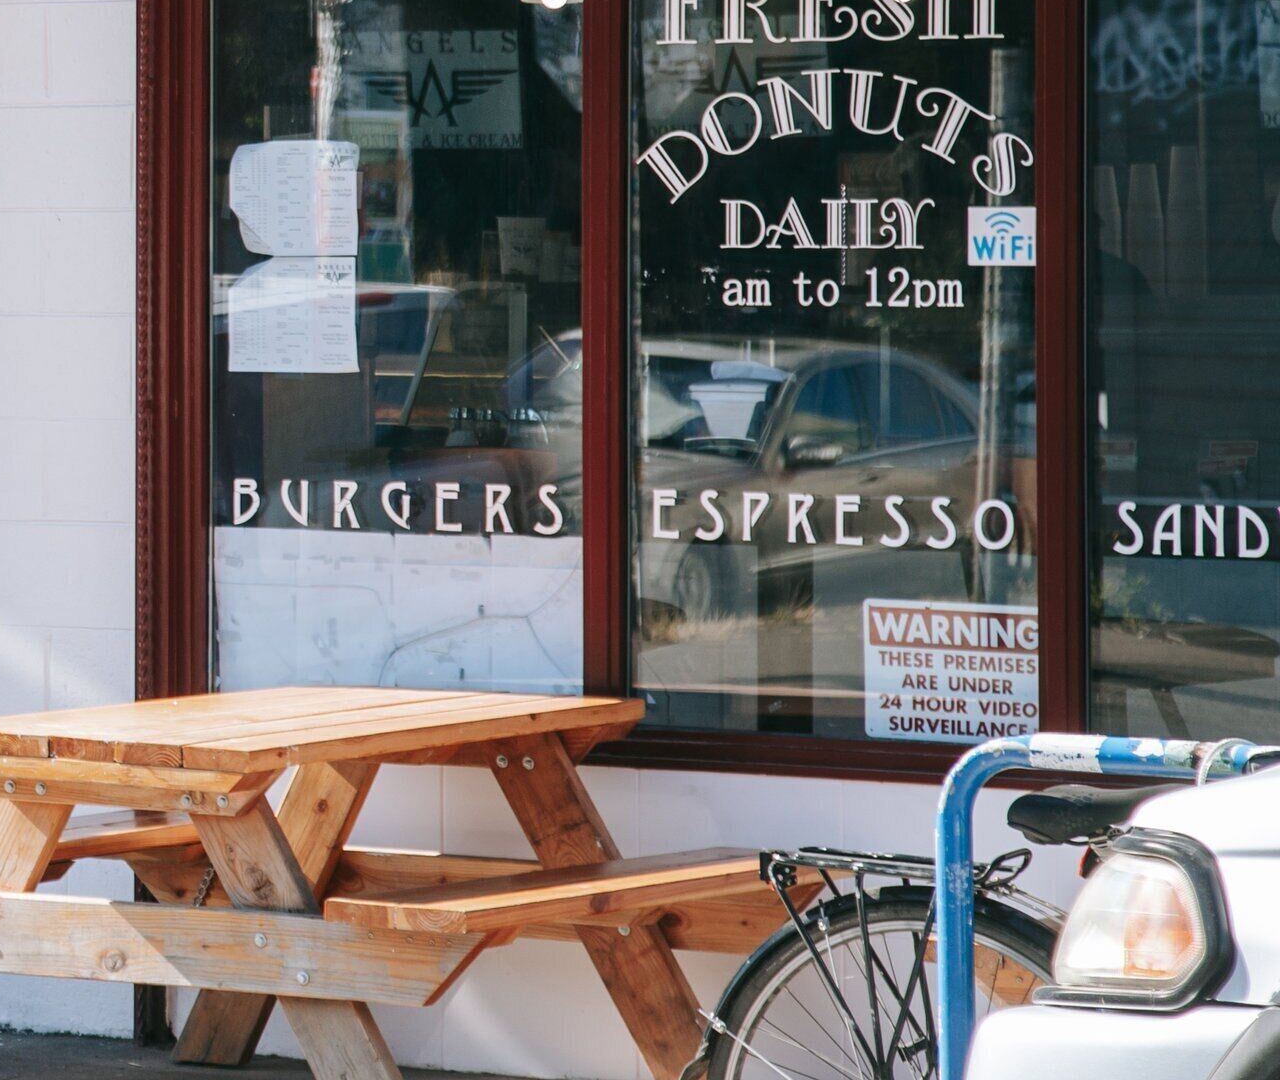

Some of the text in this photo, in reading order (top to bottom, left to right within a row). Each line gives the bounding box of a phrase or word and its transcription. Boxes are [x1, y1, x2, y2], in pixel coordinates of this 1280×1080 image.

[637, 69, 1034, 204] DONUTS
[720, 195, 935, 249] DAILY
[972, 235, 1034, 262] WiFi
[722, 267, 965, 308] am to 12pm
[232, 477, 564, 536] BURGERS
[652, 488, 1015, 551] ESPRESSO
[1113, 500, 1280, 559] SAND
[872, 611, 1038, 651] WARNING
[879, 650, 1036, 674] THESE PREMISES
[901, 674, 1013, 695] ARE UNDER
[879, 694, 1038, 718] 24 HOUR VIDEO
[889, 716, 1028, 738] SURVEILLANCE
